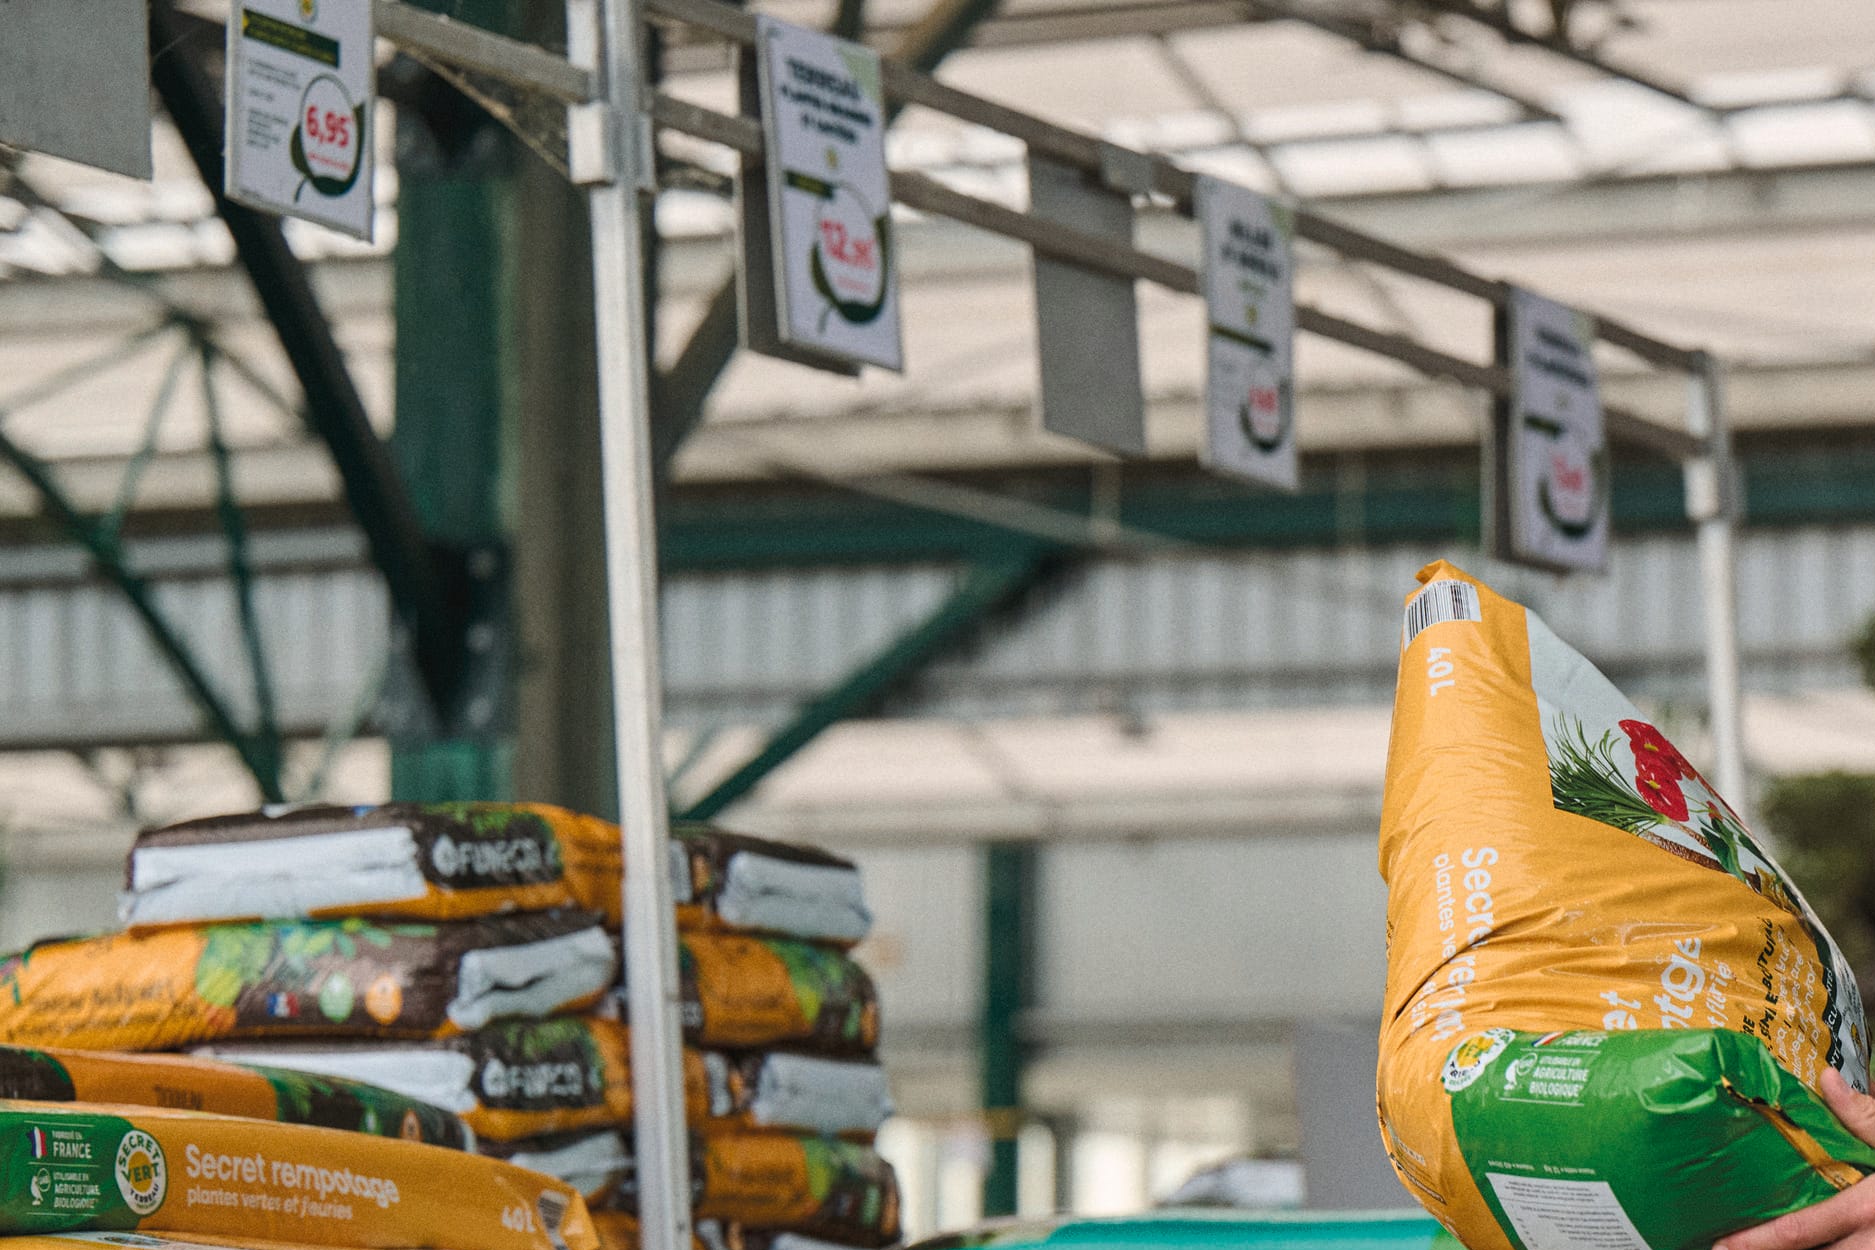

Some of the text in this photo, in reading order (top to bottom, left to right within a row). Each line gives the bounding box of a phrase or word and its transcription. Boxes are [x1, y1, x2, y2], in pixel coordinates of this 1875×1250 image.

[306, 105, 350, 147] 6,95
[1533, 1067, 1590, 1083] AGRICULTURE
[53, 1141, 92, 1159] FRANCE
[118, 1134, 160, 1167] SECRET
[121, 1162, 160, 1184] VERT
[185, 1143, 400, 1208] Secret rempotage
[186, 1186, 239, 1209] plantes
[240, 1193, 281, 1214] vertes
[283, 1196, 299, 1214] et
